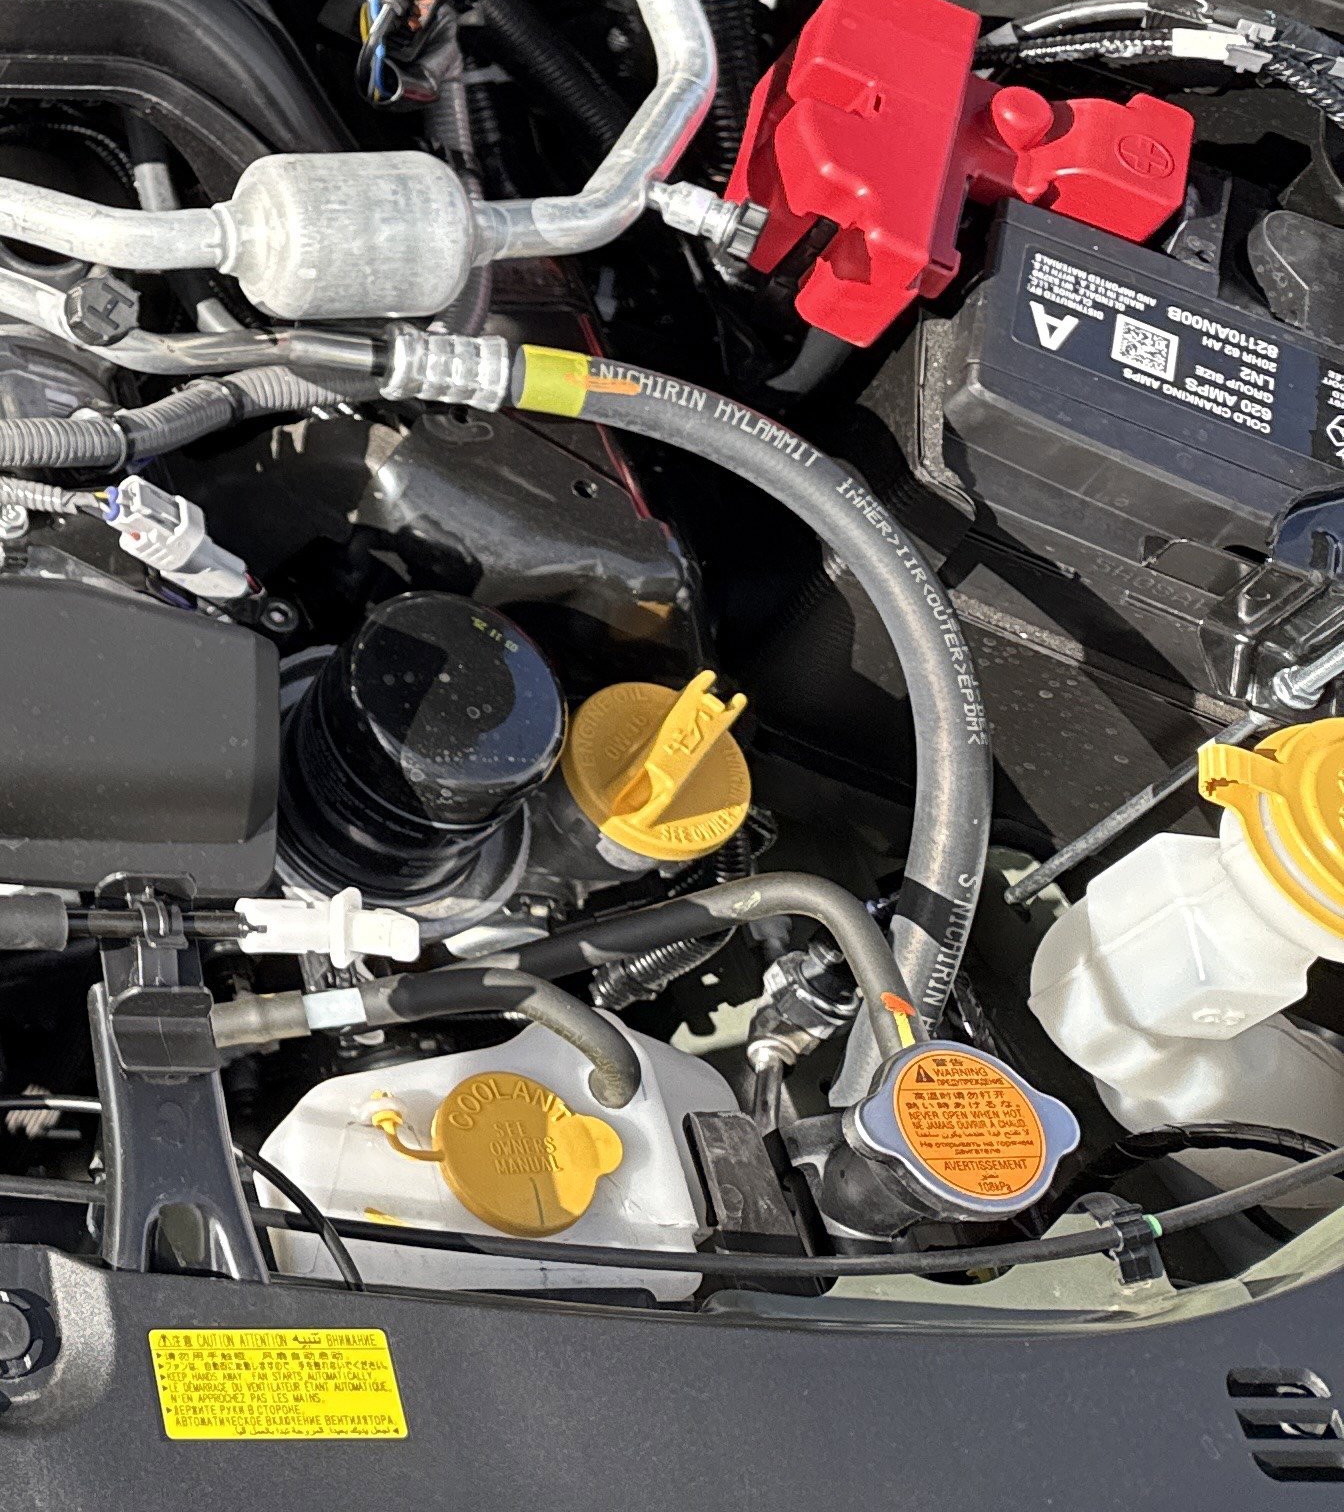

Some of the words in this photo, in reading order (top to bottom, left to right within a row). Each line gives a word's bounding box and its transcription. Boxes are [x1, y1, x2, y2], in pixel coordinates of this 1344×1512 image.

[1106, 289, 1117, 299] IN
[1118, 296, 1145, 311] MADE
[1136, 292, 1157, 307] AND
[1043, 290, 1104, 321] DISTRIBUTED
[1029, 300, 1079, 351] A
[1167, 306, 1279, 359] 82110AN00B
[1202, 335, 1223, 351] AH
[1224, 344, 1240, 358] 62
[1241, 351, 1278, 373] 20HR
[1123, 368, 1162, 390] AMPS
[1195, 365, 1225, 384] SIZE
[1239, 365, 1275, 391] LN2
[1162, 383, 1231, 419] CRANKING
[1185, 377, 1238, 407] AMPS
[1226, 379, 1274, 404] GROUP
[1240, 399, 1272, 421] 620
[1233, 412, 1271, 434] COLD
[713, 399, 822, 468] HYLAMMIT
[663, 824, 691, 844] SEE
[933, 1067, 989, 1077] WARNING
[448, 1078, 574, 1131] COOLANT
[908, 1111, 939, 1121] NEVER
[942, 1110, 968, 1120] OPEN
[971, 1109, 1000, 1119] WHEN
[927, 1120, 955, 1129] JAMAIS
[493, 1120, 527, 1138] SEE
[494, 1154, 564, 1176] MANUAL
[944, 1159, 1028, 1171] AVERTISSEMENT
[196, 1333, 234, 1347] CAUTION
[239, 1333, 288, 1347] ATTENTION
[326, 1333, 378, 1347] ВНИМАНИЕ
[167, 1371, 187, 1381] KEEP
[192, 1371, 218, 1381] HANDS
[272, 1371, 303, 1381] STARTS
[232, 1382, 243, 1392] DU
[246, 1382, 300, 1392] VENTILATEUR
[198, 1393, 246, 1403] APPROCHEZ
[250, 1393, 267, 1403] PAS
[272, 1393, 289, 1403] LES
